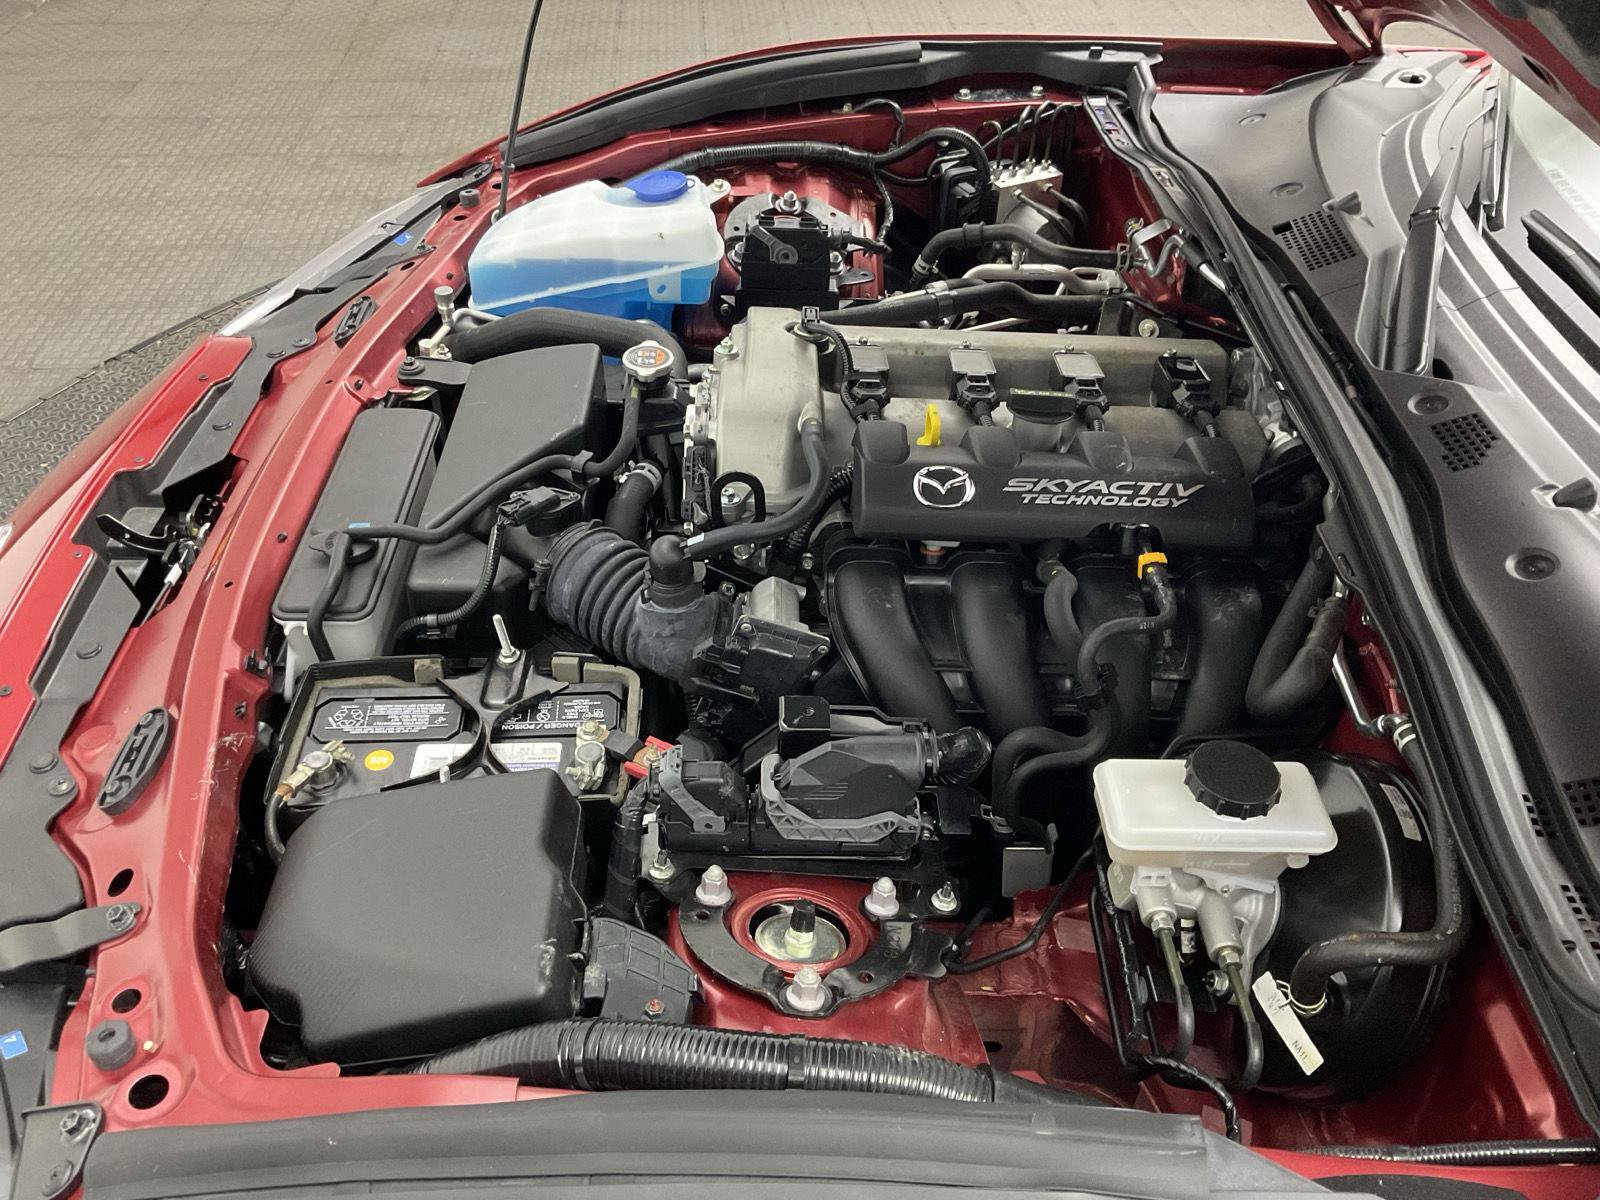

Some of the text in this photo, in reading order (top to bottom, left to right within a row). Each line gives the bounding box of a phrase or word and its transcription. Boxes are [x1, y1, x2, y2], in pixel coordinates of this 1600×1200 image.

[1003, 477, 1205, 497] SKYACTIV
[1020, 493, 1189, 508] TECHNOLOGY
[501, 723, 535, 731] POISON
